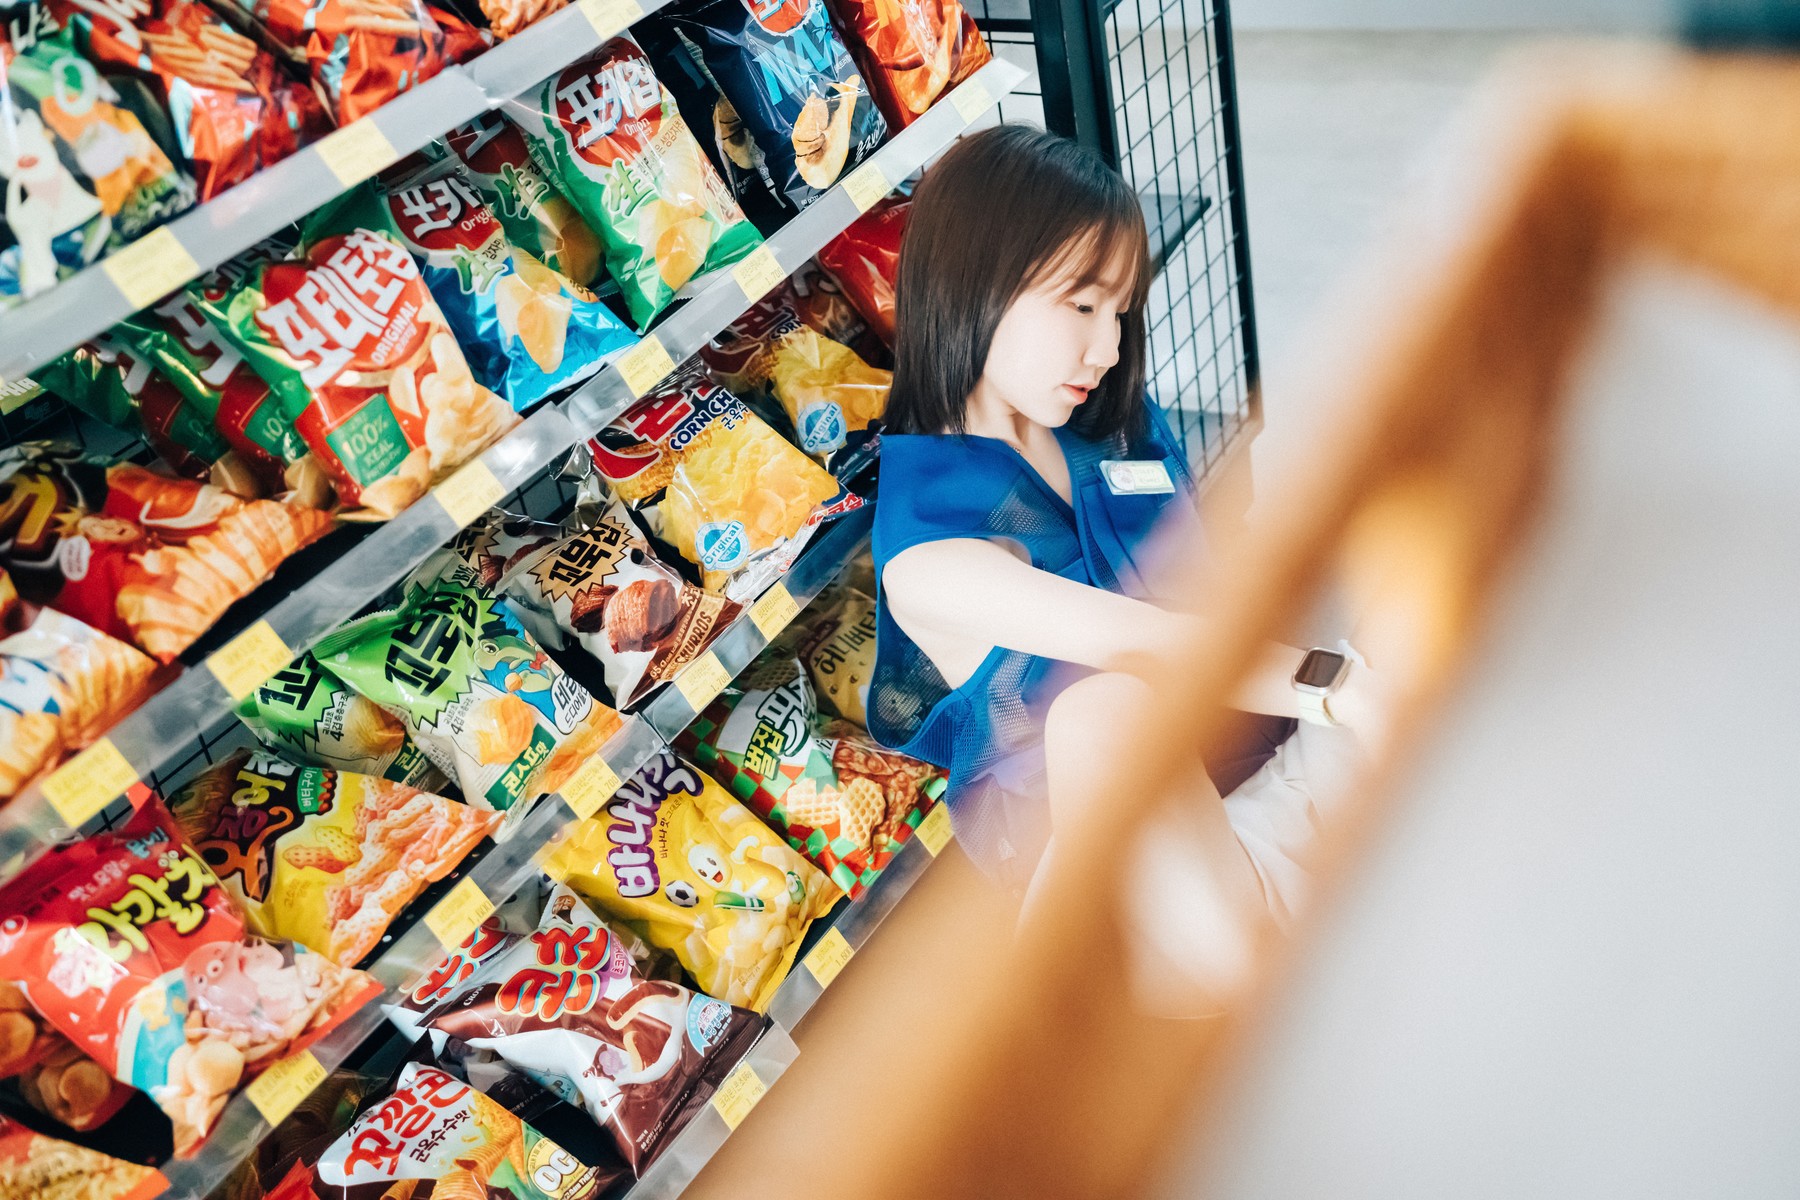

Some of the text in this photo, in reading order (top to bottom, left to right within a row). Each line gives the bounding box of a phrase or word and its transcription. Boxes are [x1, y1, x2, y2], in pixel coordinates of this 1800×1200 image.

[557, 54, 662, 150] 포카칩
[623, 117, 650, 137] Onion
[392, 178, 486, 239] 포카
[766, 267, 784, 287] 1,700
[255, 228, 419, 389] 포테토칩
[371, 301, 420, 365] ORIGINAL
[654, 357, 674, 379] 1,700
[342, 416, 389, 460] 100%
[669, 414, 712, 451] CORN
[806, 404, 839, 449] Original
[365, 437, 395, 467] REAL
[550, 522, 623, 588] 꼬북칩
[703, 521, 743, 566] Original
[452, 563, 476, 582] BIG
[780, 602, 798, 622] 1,700
[675, 611, 713, 664] CHURROS
[710, 672, 731, 693] 1,700
[501, 743, 551, 798] 콘스프맛
[744, 721, 784, 780] 벌집
[301, 767, 316, 808] 버터구이
[599, 776, 620, 798] 1,700
[463, 982, 485, 1006] CROW
[343, 1069, 471, 1176] 꼬깔콘
[410, 1109, 470, 1163] 군옥수수맛
